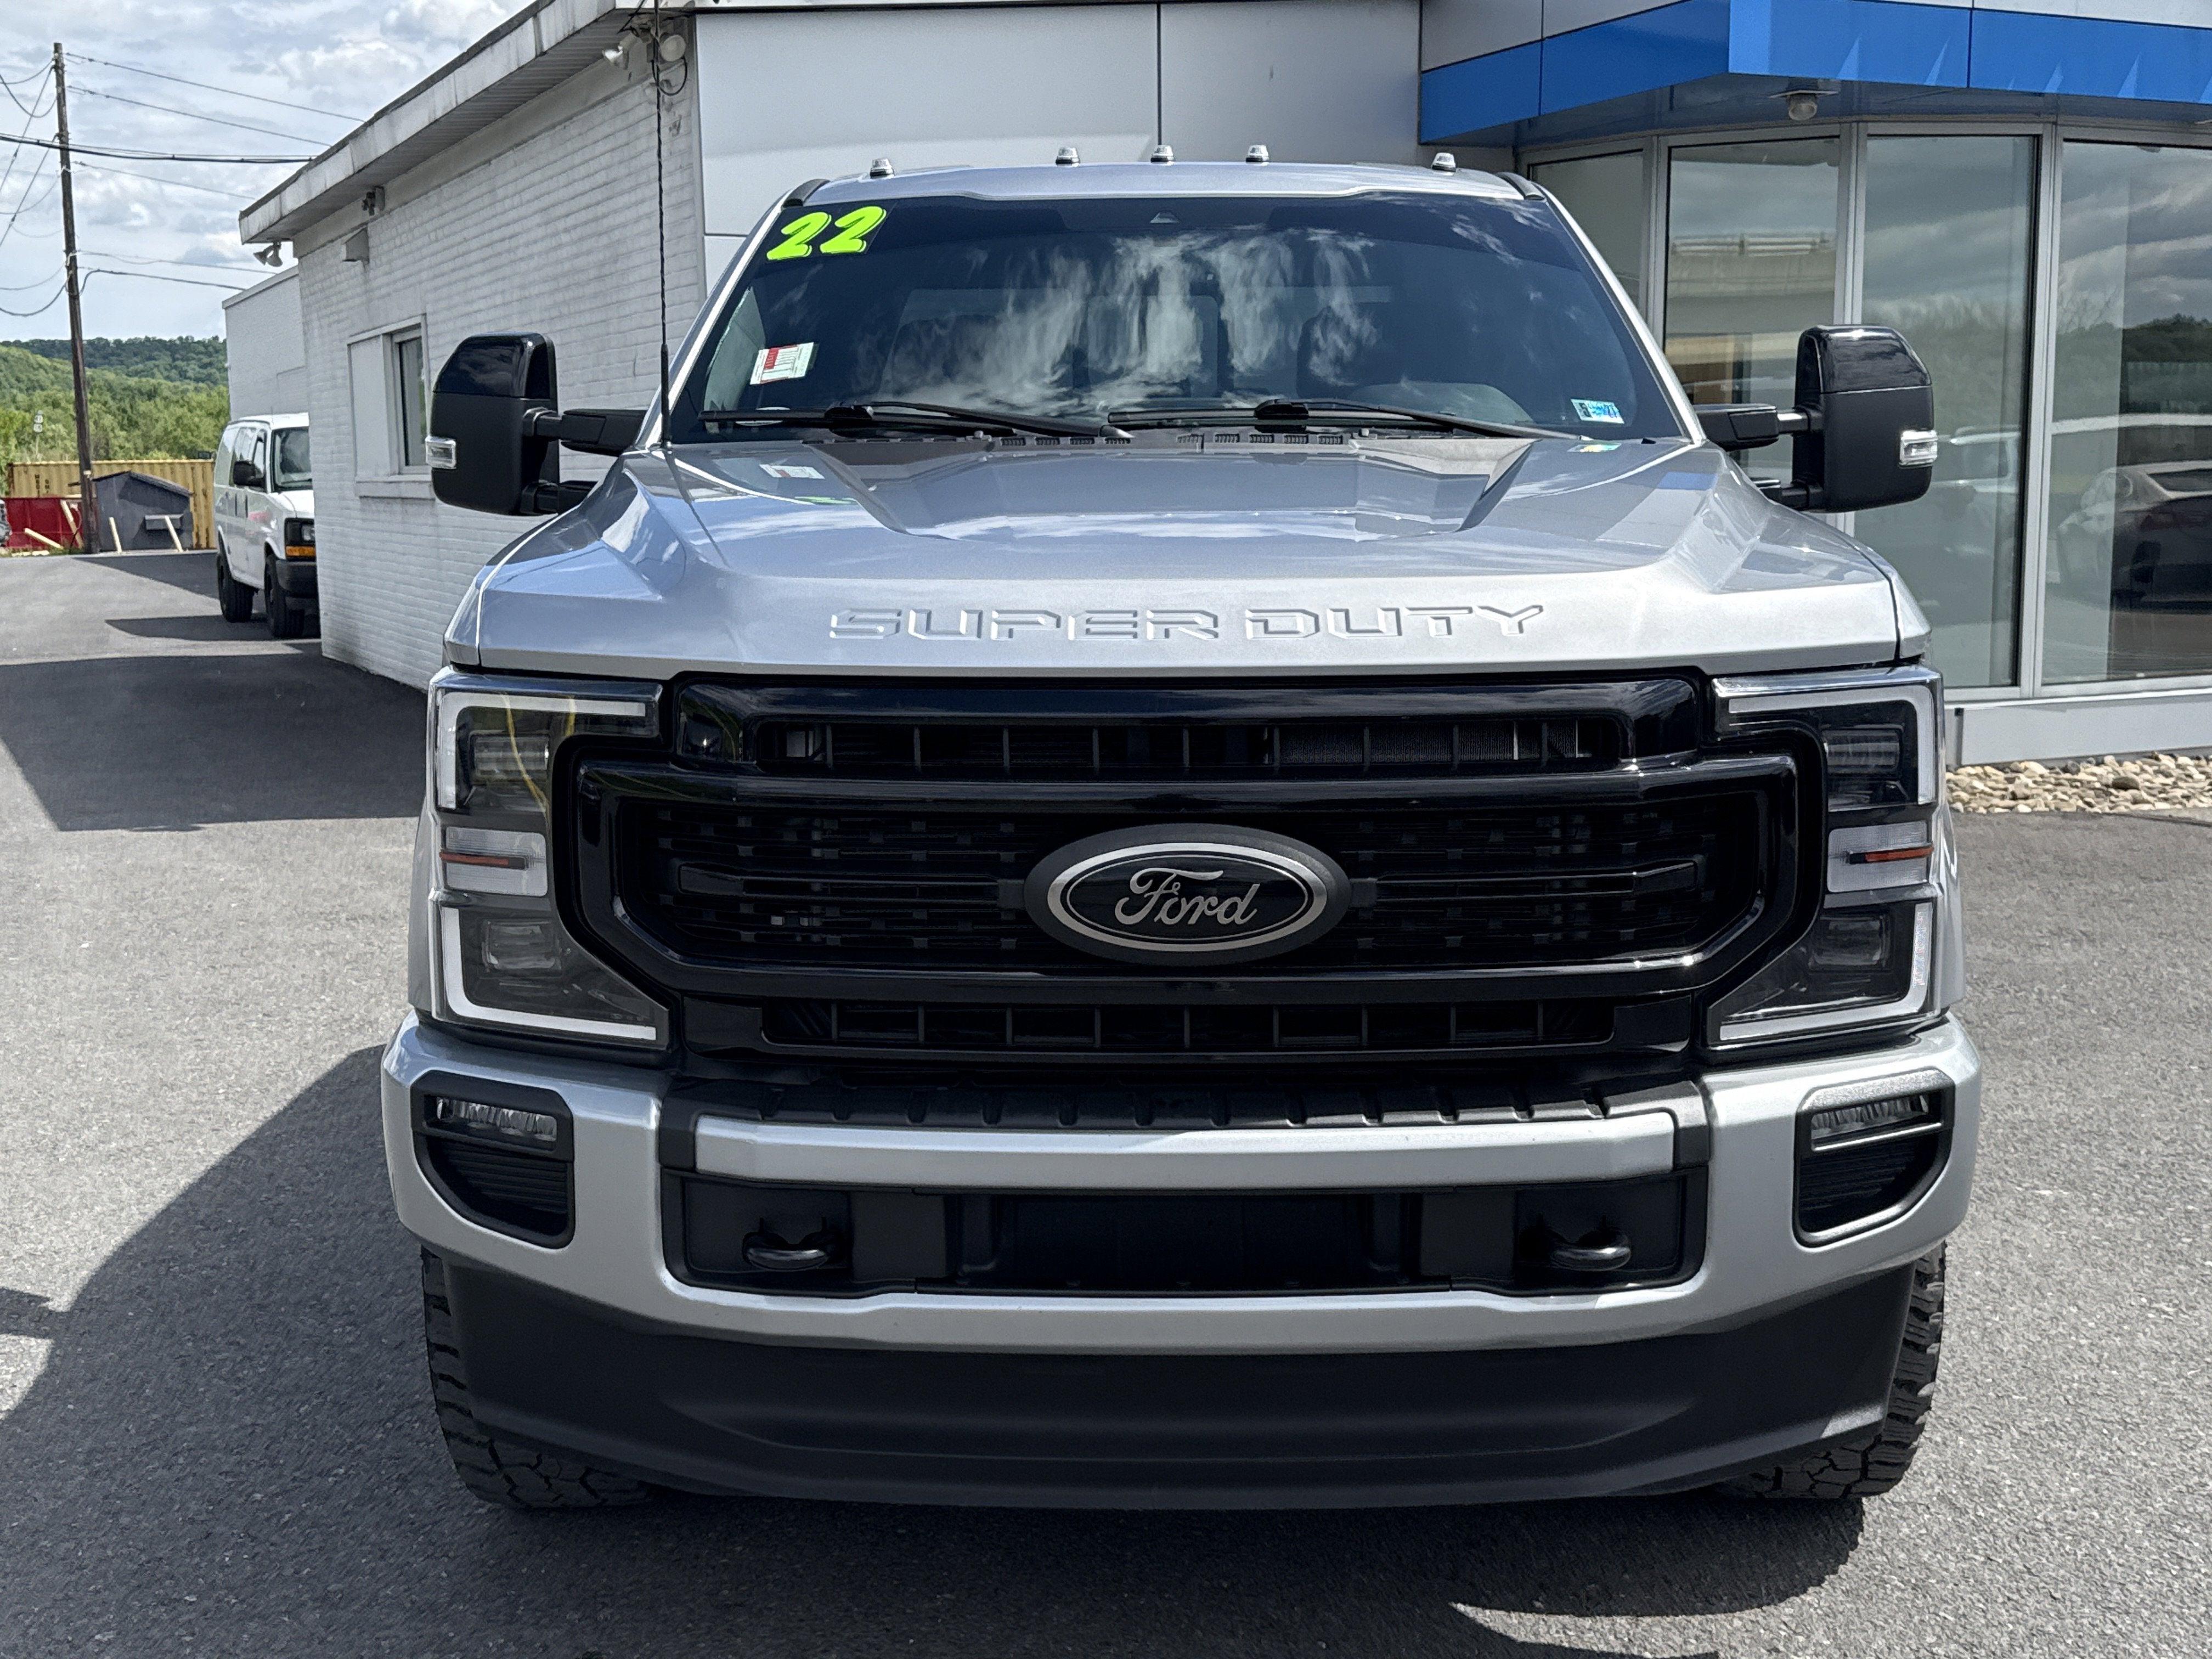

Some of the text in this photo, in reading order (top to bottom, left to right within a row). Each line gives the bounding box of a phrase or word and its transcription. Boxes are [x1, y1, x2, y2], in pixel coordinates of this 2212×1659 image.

[766, 206, 887, 260] 22
[828, 605, 1544, 641] SUPER DUTY
[1114, 867, 1261, 926] Ford
